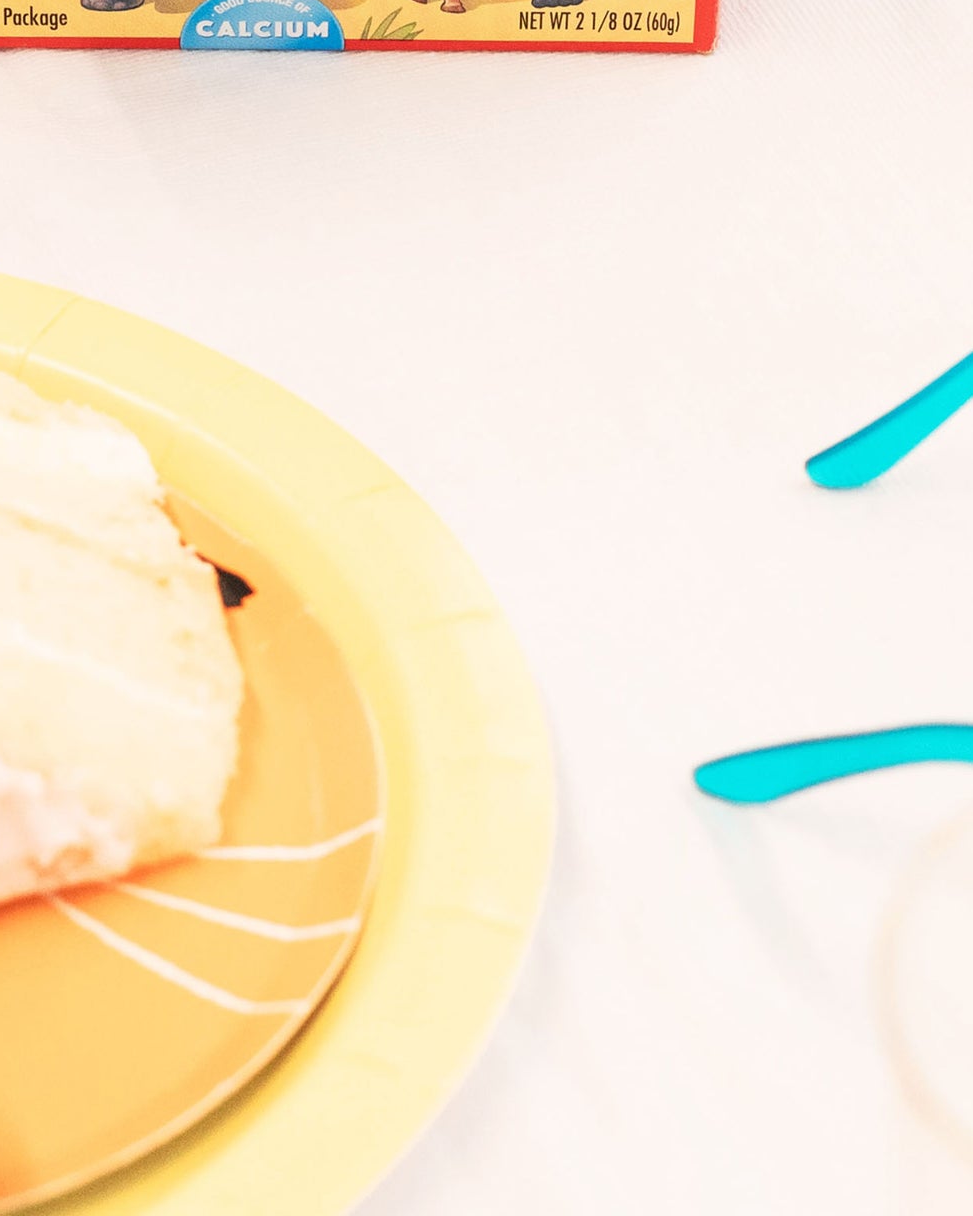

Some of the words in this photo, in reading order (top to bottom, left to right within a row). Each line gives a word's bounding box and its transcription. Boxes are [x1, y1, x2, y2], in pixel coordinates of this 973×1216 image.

[3, 5, 69, 31] Package
[294, 1, 313, 15] OF
[194, 19, 330, 38] CALCIUM
[518, 11, 546, 30] NET
[549, 11, 572, 30] WT
[576, 11, 585, 31] 2
[591, 10, 618, 33] 1/8
[622, 12, 643, 31] OZ
[646, 11, 681, 36] (60g)
